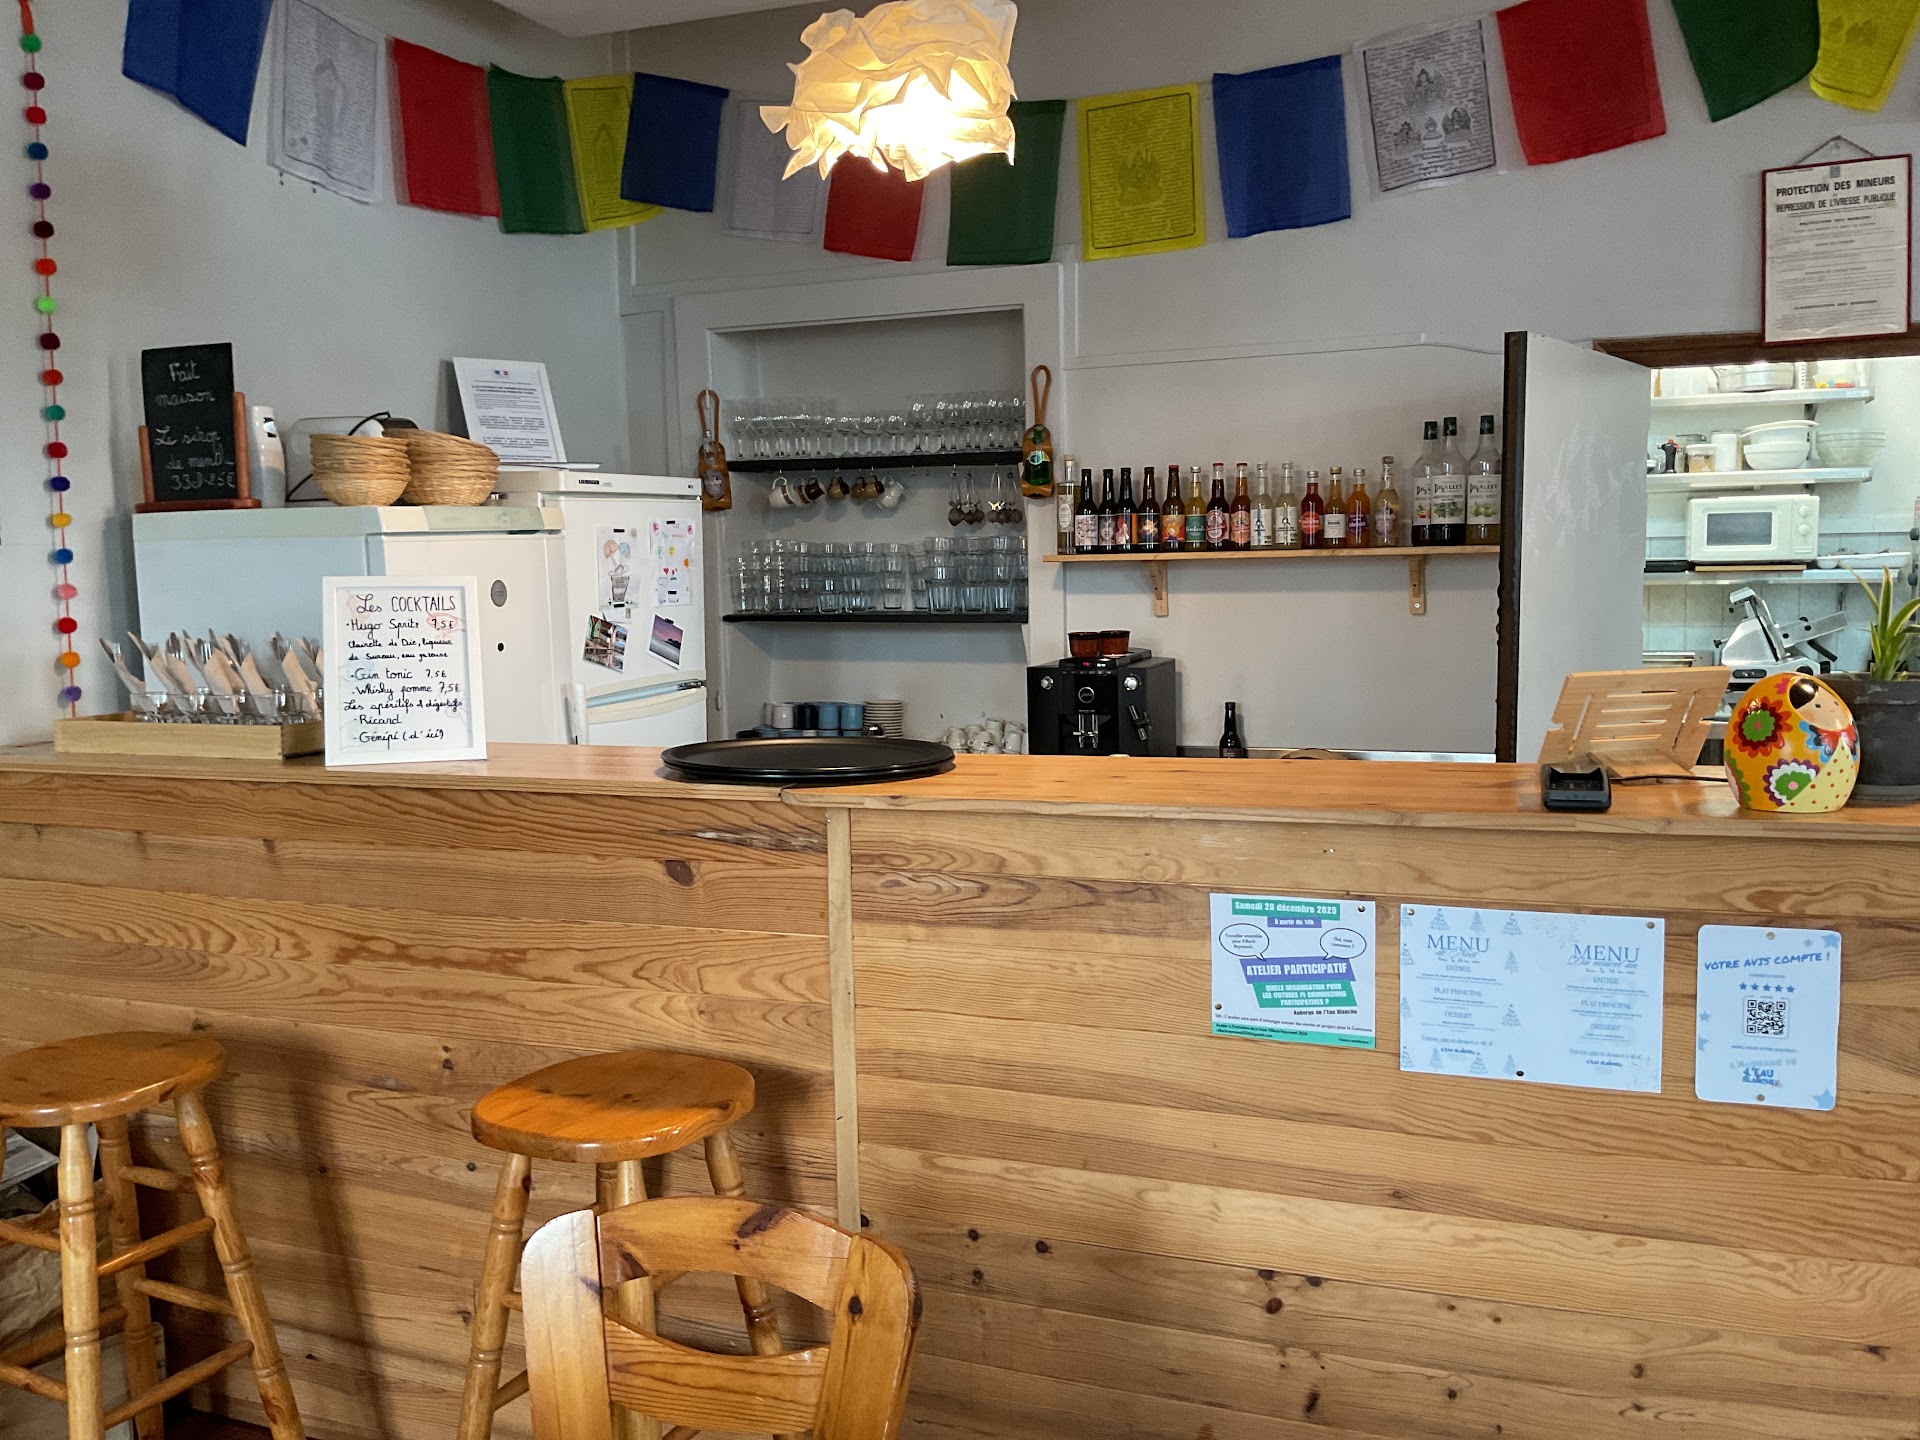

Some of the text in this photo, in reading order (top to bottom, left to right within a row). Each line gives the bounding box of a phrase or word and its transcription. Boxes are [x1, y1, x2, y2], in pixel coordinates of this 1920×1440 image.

[1776, 176, 1895, 197] PROTECTION DES MINEURS
[1776, 201, 1815, 213] REPRESSION
[1818, 200, 1826, 208] DE
[1830, 196, 1860, 207] L'IVRESSE
[1863, 192, 1896, 203] PUBLIQUE
[169, 359, 200, 382] Fait
[155, 391, 216, 406] maison
[356, 593, 382, 614] Les
[351, 619, 383, 639] Hugo
[388, 639, 398, 647] de
[422, 638, 453, 650] liqueur
[354, 668, 380, 680] Gin
[386, 668, 413, 679] tonic
[356, 683, 394, 700] Whisky
[400, 685, 433, 701] pomme
[343, 700, 364, 712] Les
[369, 698, 414, 715] apéritifs
[359, 714, 403, 725] Ricard
[359, 731, 399, 750] Génépi
[1234, 901, 1337, 914] Samedi 20 décembre 2025
[1426, 933, 1490, 953] MENU
[1573, 943, 1640, 963] MENU
[1704, 952, 1831, 971] VOTRE AVIS COMPTE !
[1246, 962, 1348, 976] ATELIER PARTICIPATIF
[1262, 991, 1273, 999] LES
[1307, 990, 1347, 998] COMMISSIONS
[1265, 983, 1284, 992] QUELLE
[1285, 983, 1325, 991] ORGANISATION
[1450, 988, 1483, 997] PRINCIPAL
[1280, 998, 1324, 1006] PARTICIPATIVES
[1598, 1001, 1634, 1010] PRINCIPAL
[1444, 1011, 1473, 1019] DESSERT
[1590, 1023, 1621, 1031] DESSERT
[1745, 1067, 1774, 1078] L'EAU
